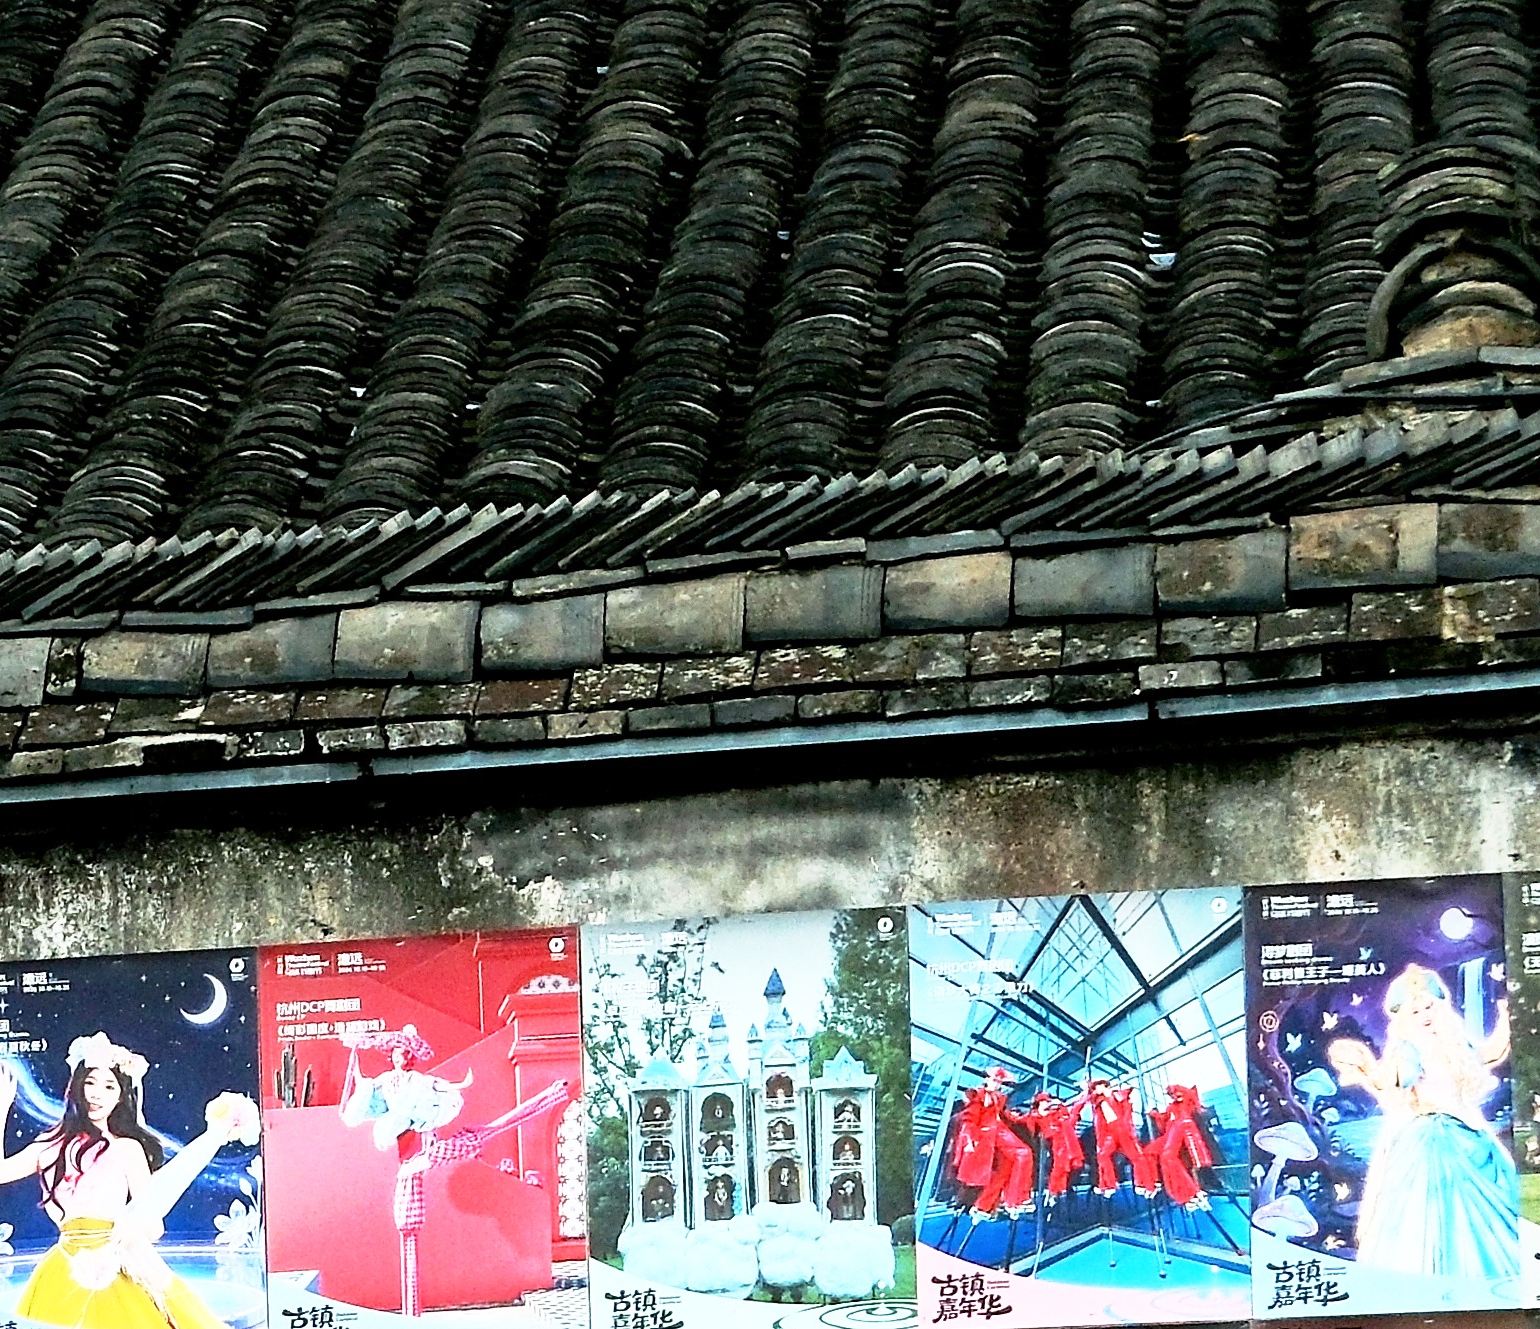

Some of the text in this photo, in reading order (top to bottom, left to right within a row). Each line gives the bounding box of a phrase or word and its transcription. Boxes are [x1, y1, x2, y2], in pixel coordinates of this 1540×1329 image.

[932, 1273, 984, 1297] 古镇
[283, 1305, 333, 1329] 古镇
[934, 1294, 1012, 1322] 嘉年华
